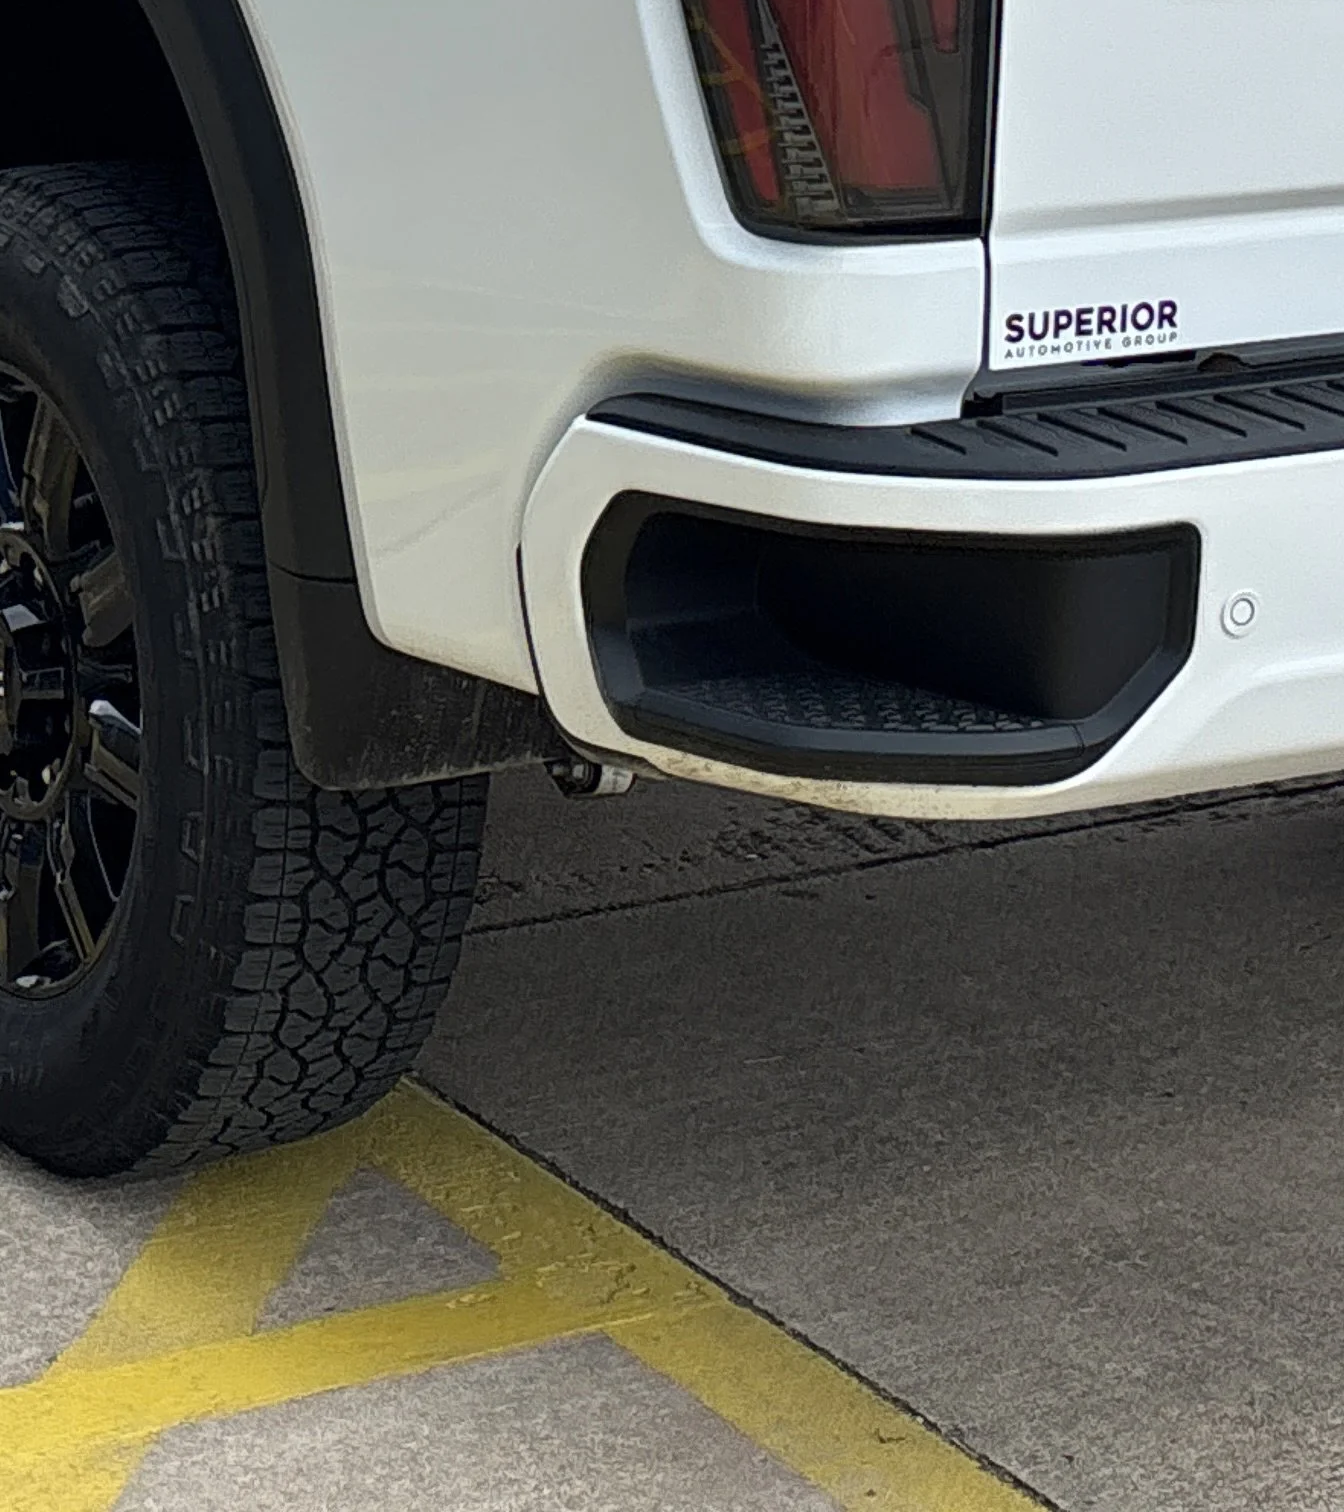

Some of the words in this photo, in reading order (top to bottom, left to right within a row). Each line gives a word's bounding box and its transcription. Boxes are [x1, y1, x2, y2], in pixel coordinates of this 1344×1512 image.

[1004, 299, 1178, 344] SUPERIOR
[1004, 337, 1113, 360] AUTOMOTIVE
[1121, 331, 1178, 348] GROUP
